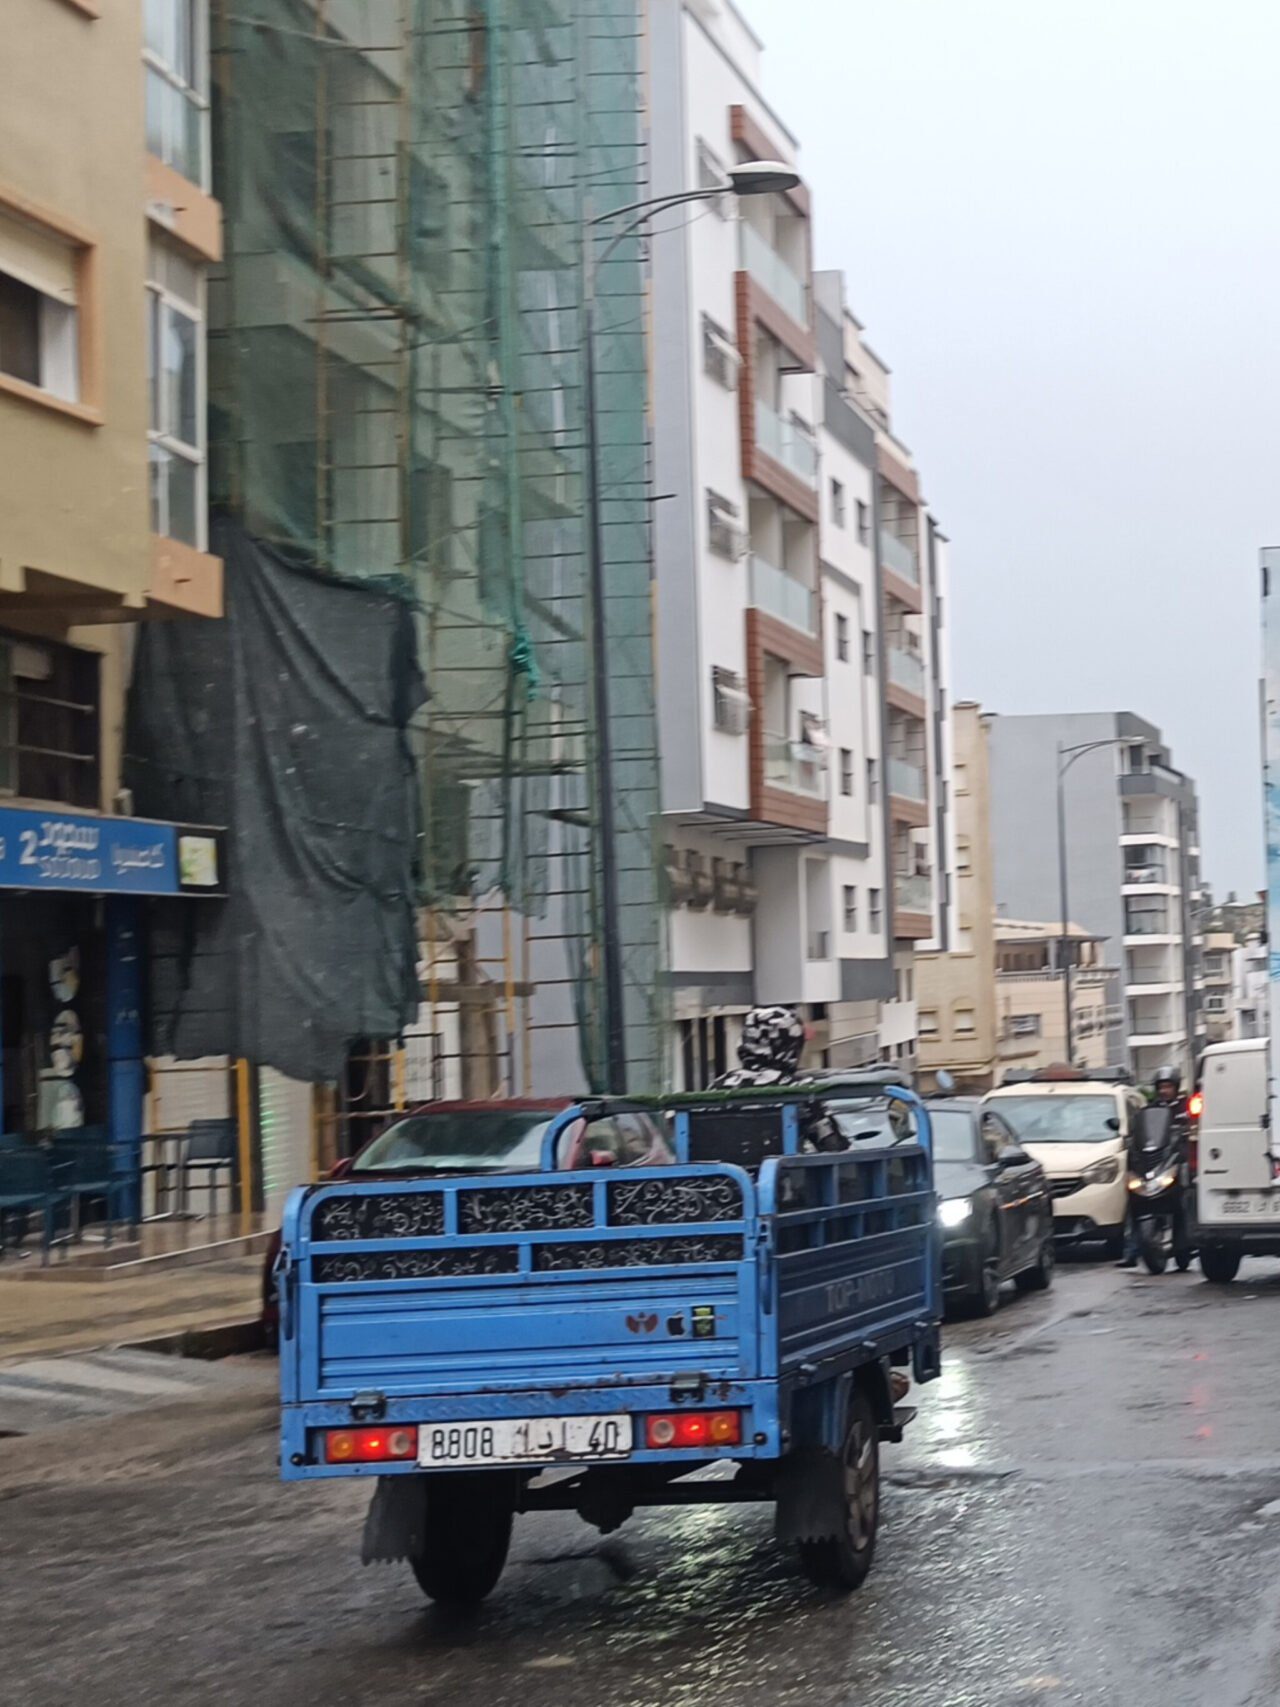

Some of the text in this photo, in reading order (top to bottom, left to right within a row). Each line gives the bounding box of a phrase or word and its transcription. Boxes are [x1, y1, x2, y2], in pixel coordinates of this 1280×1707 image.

[20, 830, 38, 865] 2
[432, 1427, 493, 1460] 8808
[588, 1421, 618, 1451] 40
